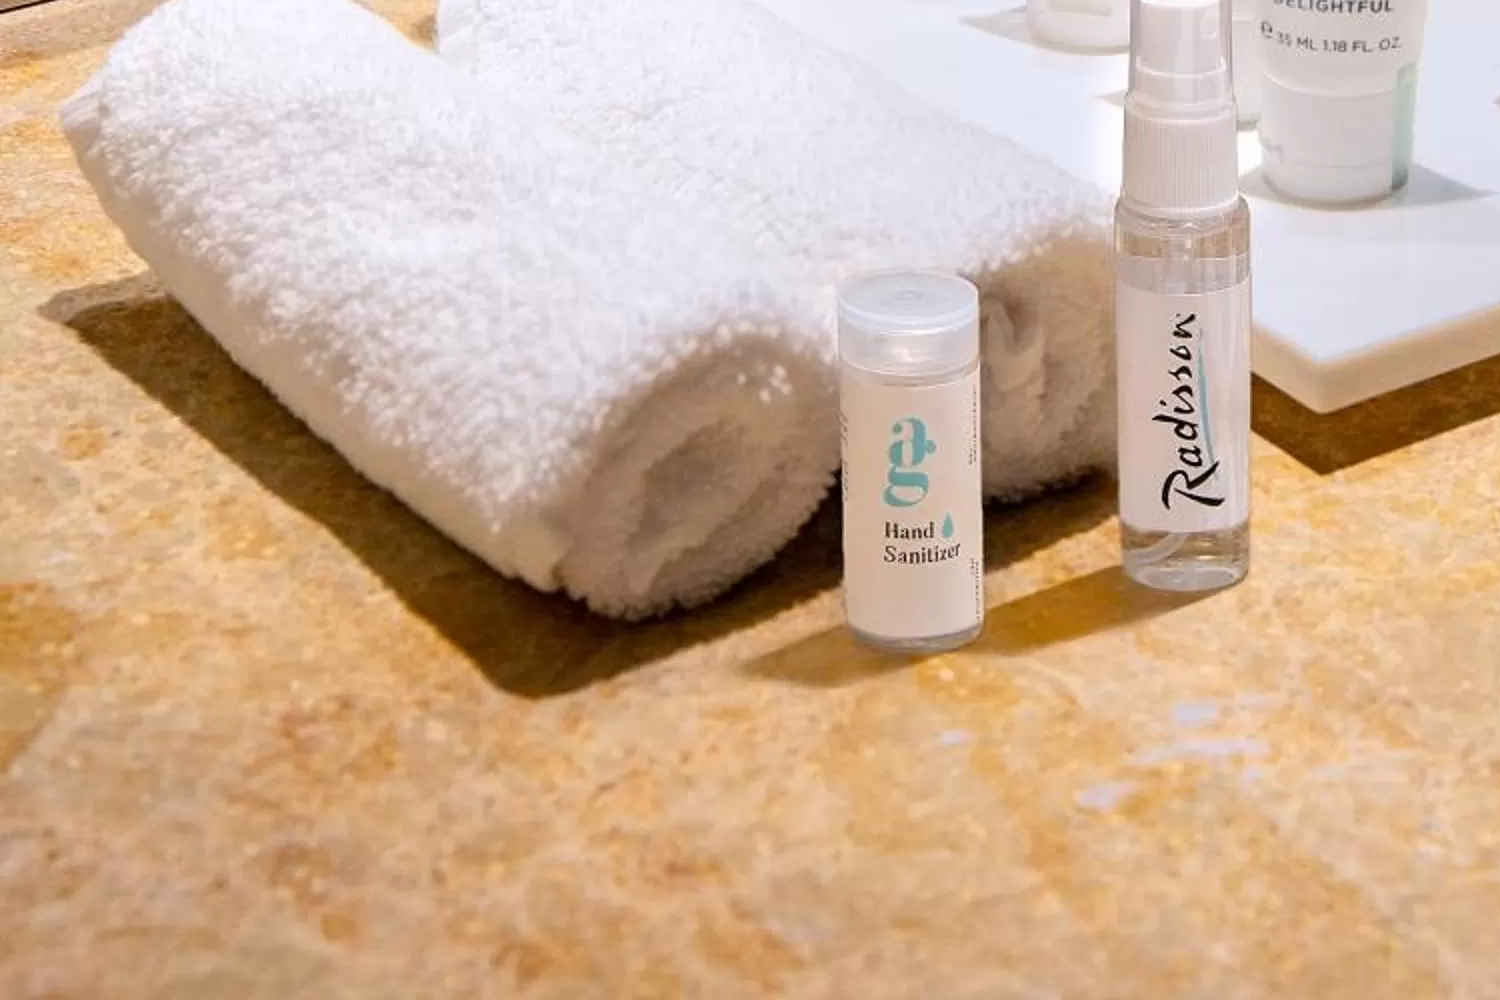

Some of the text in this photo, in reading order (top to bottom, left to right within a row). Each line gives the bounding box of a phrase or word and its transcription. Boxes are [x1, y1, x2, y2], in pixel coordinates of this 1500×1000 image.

[1297, 36, 1318, 51] ML
[1152, 313, 1226, 510] Radisson
[884, 521, 935, 540] Hand
[883, 543, 961, 565] Sanitizer
